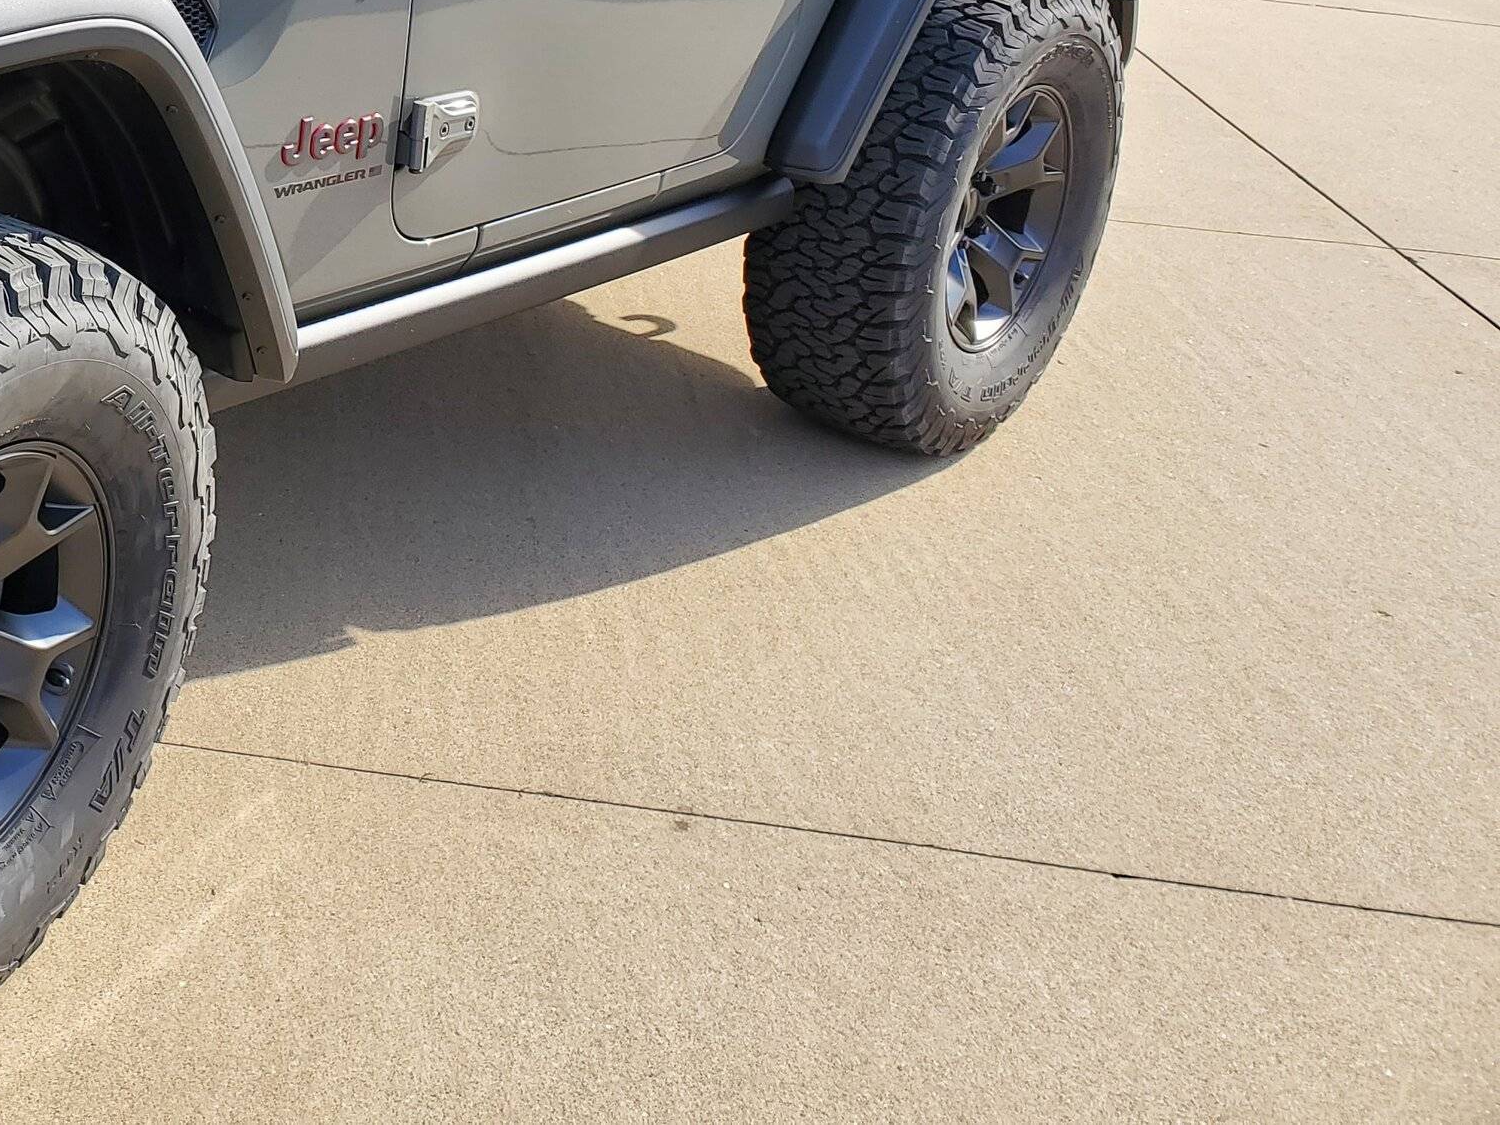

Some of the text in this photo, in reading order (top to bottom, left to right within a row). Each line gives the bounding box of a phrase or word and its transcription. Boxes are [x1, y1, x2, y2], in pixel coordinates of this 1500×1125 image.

[280, 111, 384, 167] Jeep
[273, 168, 367, 199] WRANGLER
[89, 383, 181, 814] All-Terrain T/A
